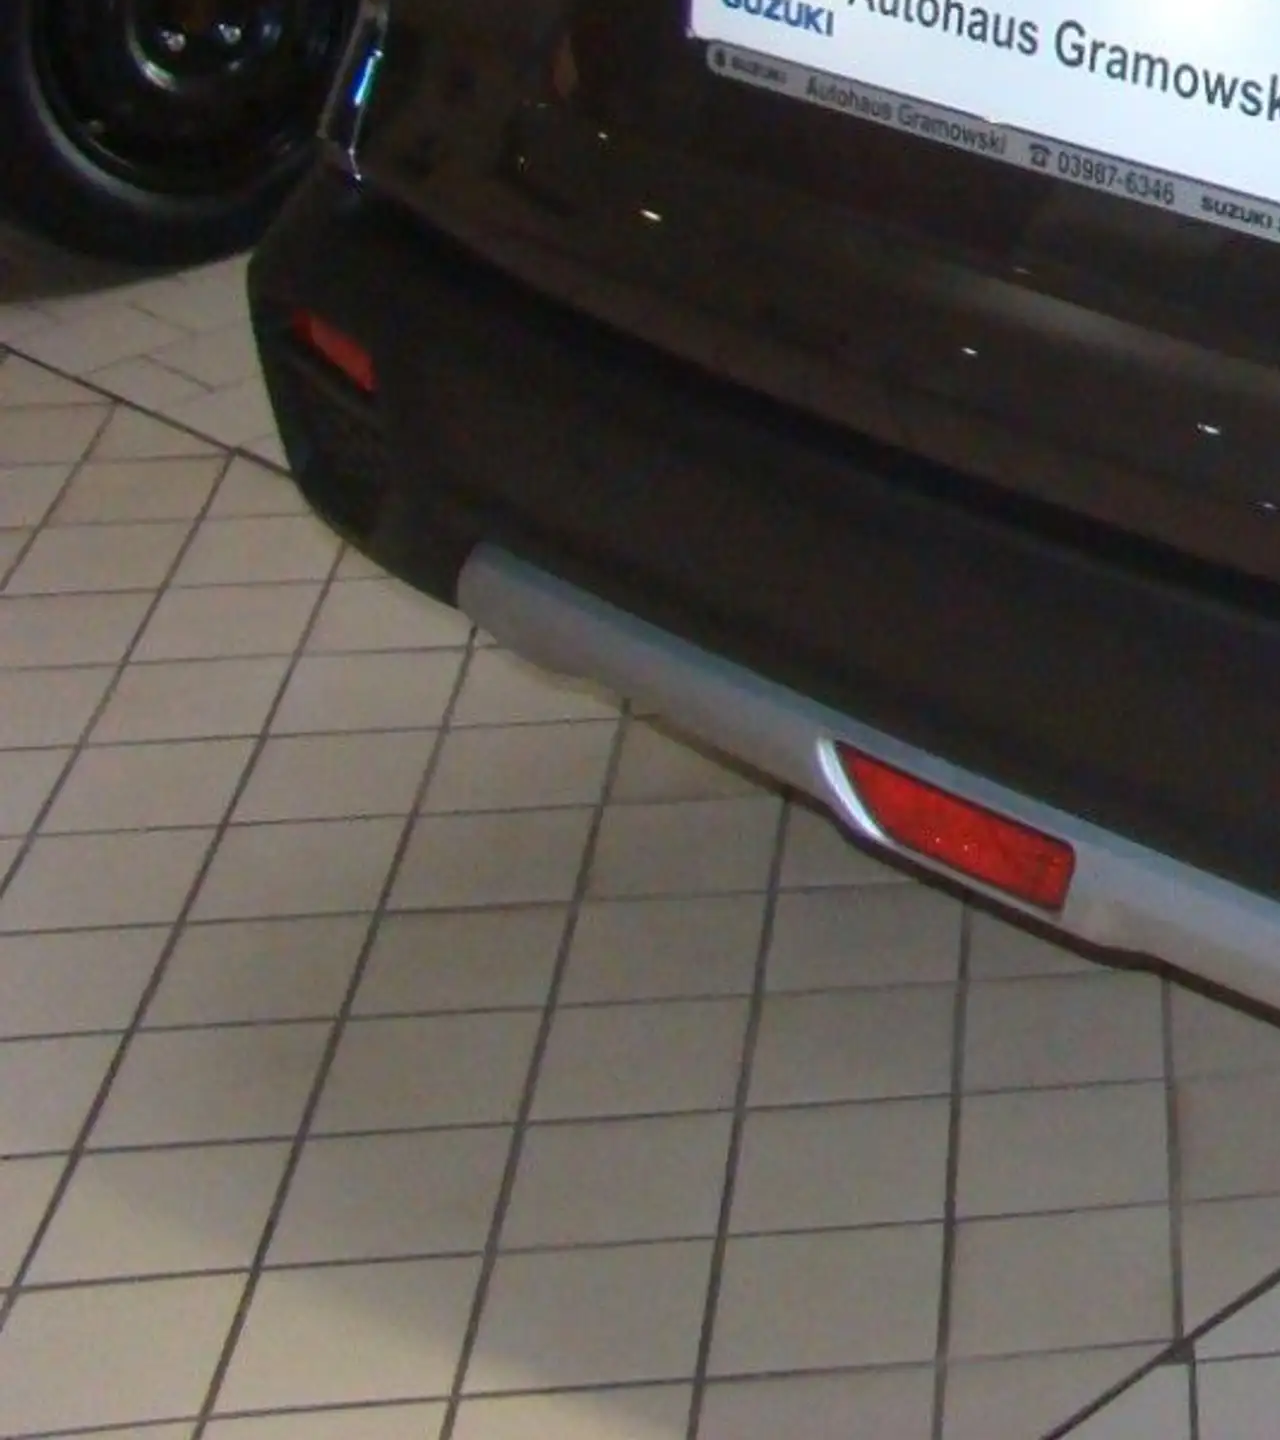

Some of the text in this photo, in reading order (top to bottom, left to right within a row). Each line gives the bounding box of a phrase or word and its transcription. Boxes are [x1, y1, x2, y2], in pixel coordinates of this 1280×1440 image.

[804, 75, 892, 119] Autohaus
[897, 102, 1008, 156] Gramowski
[1057, 150, 1176, 206] 03987-6346
[1201, 195, 1274, 229] SUZUKI
